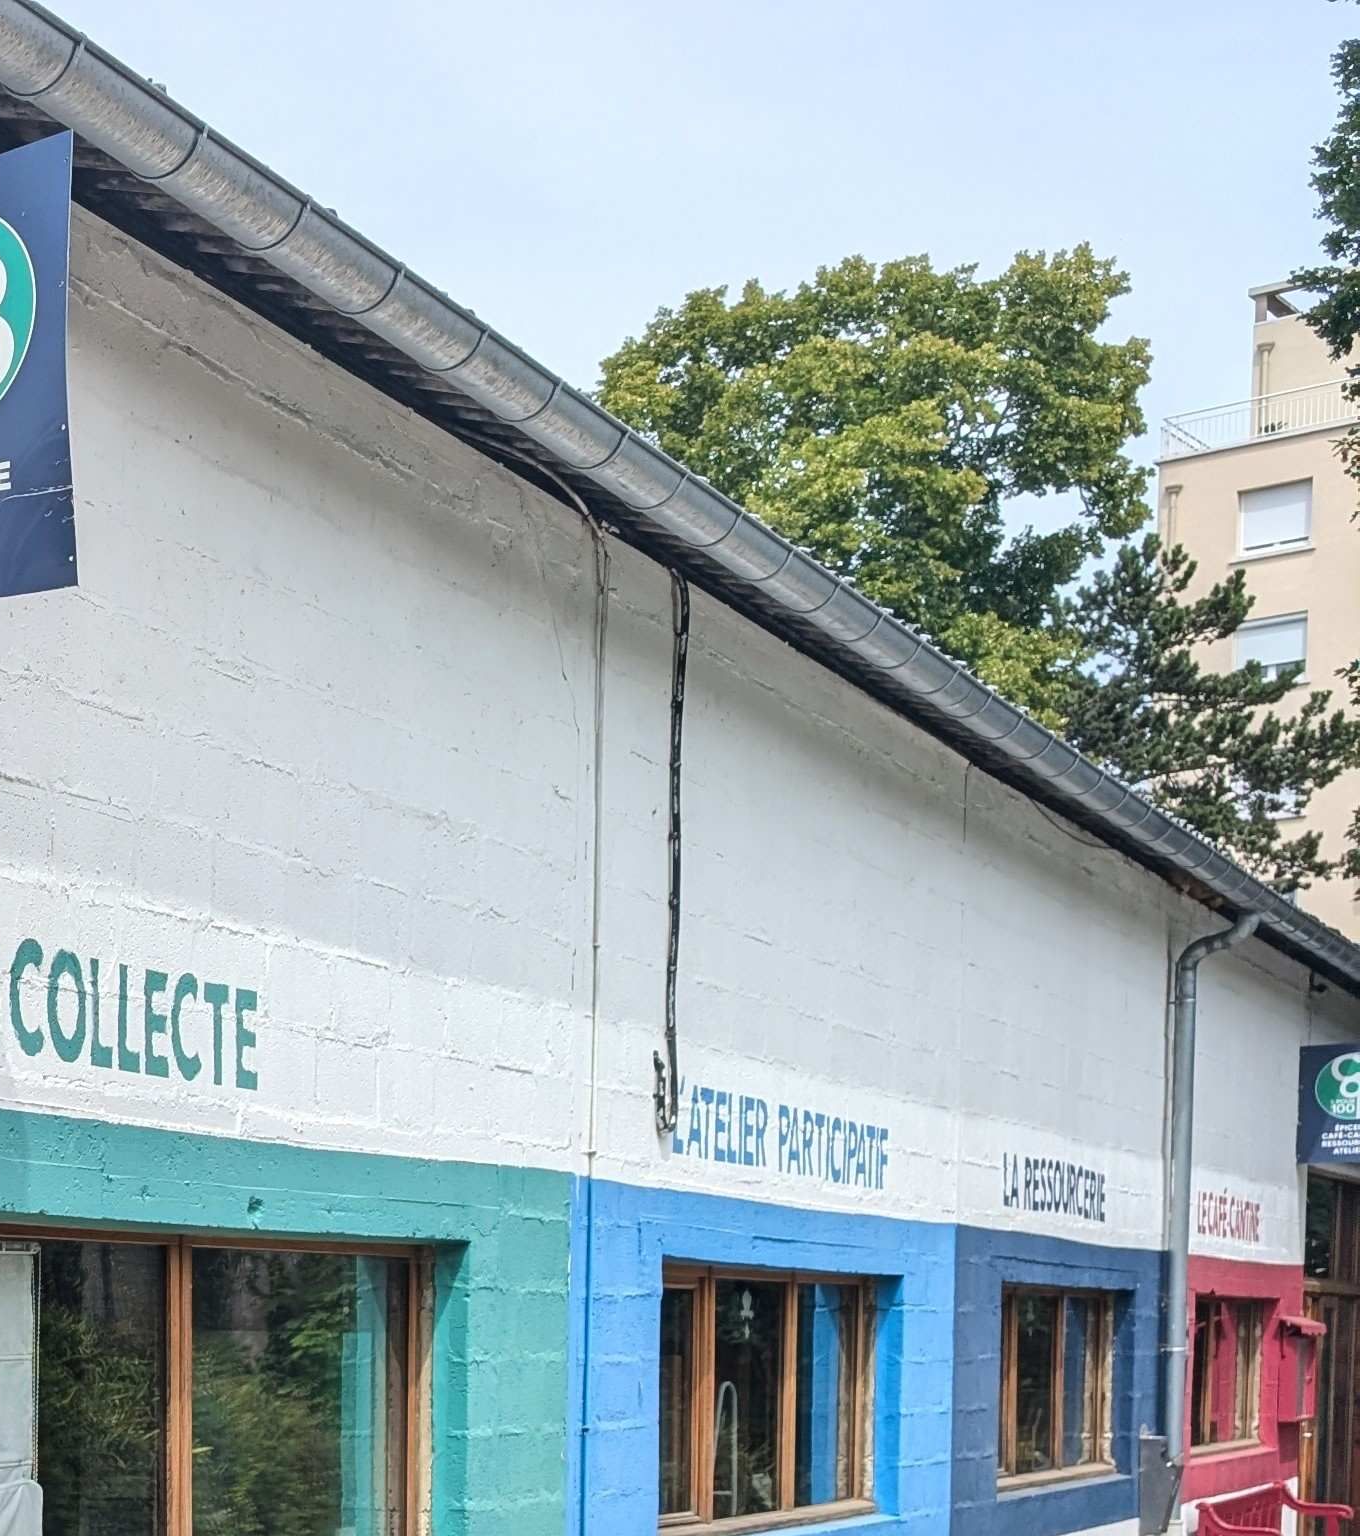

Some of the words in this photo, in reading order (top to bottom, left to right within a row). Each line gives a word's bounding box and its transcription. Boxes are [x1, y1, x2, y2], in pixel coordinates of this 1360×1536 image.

[9, 938, 259, 1091] COLLECTE
[1332, 1103, 1355, 1114] 100
[779, 1104, 888, 1190] PARTICIPATIF
[1003, 1152, 1019, 1209] LA
[1024, 1157, 1106, 1223] RESSOURCERIE
[1197, 1191, 1206, 1235] LE
[1207, 1188, 1261, 1243] CAFÉ-CANTINE
